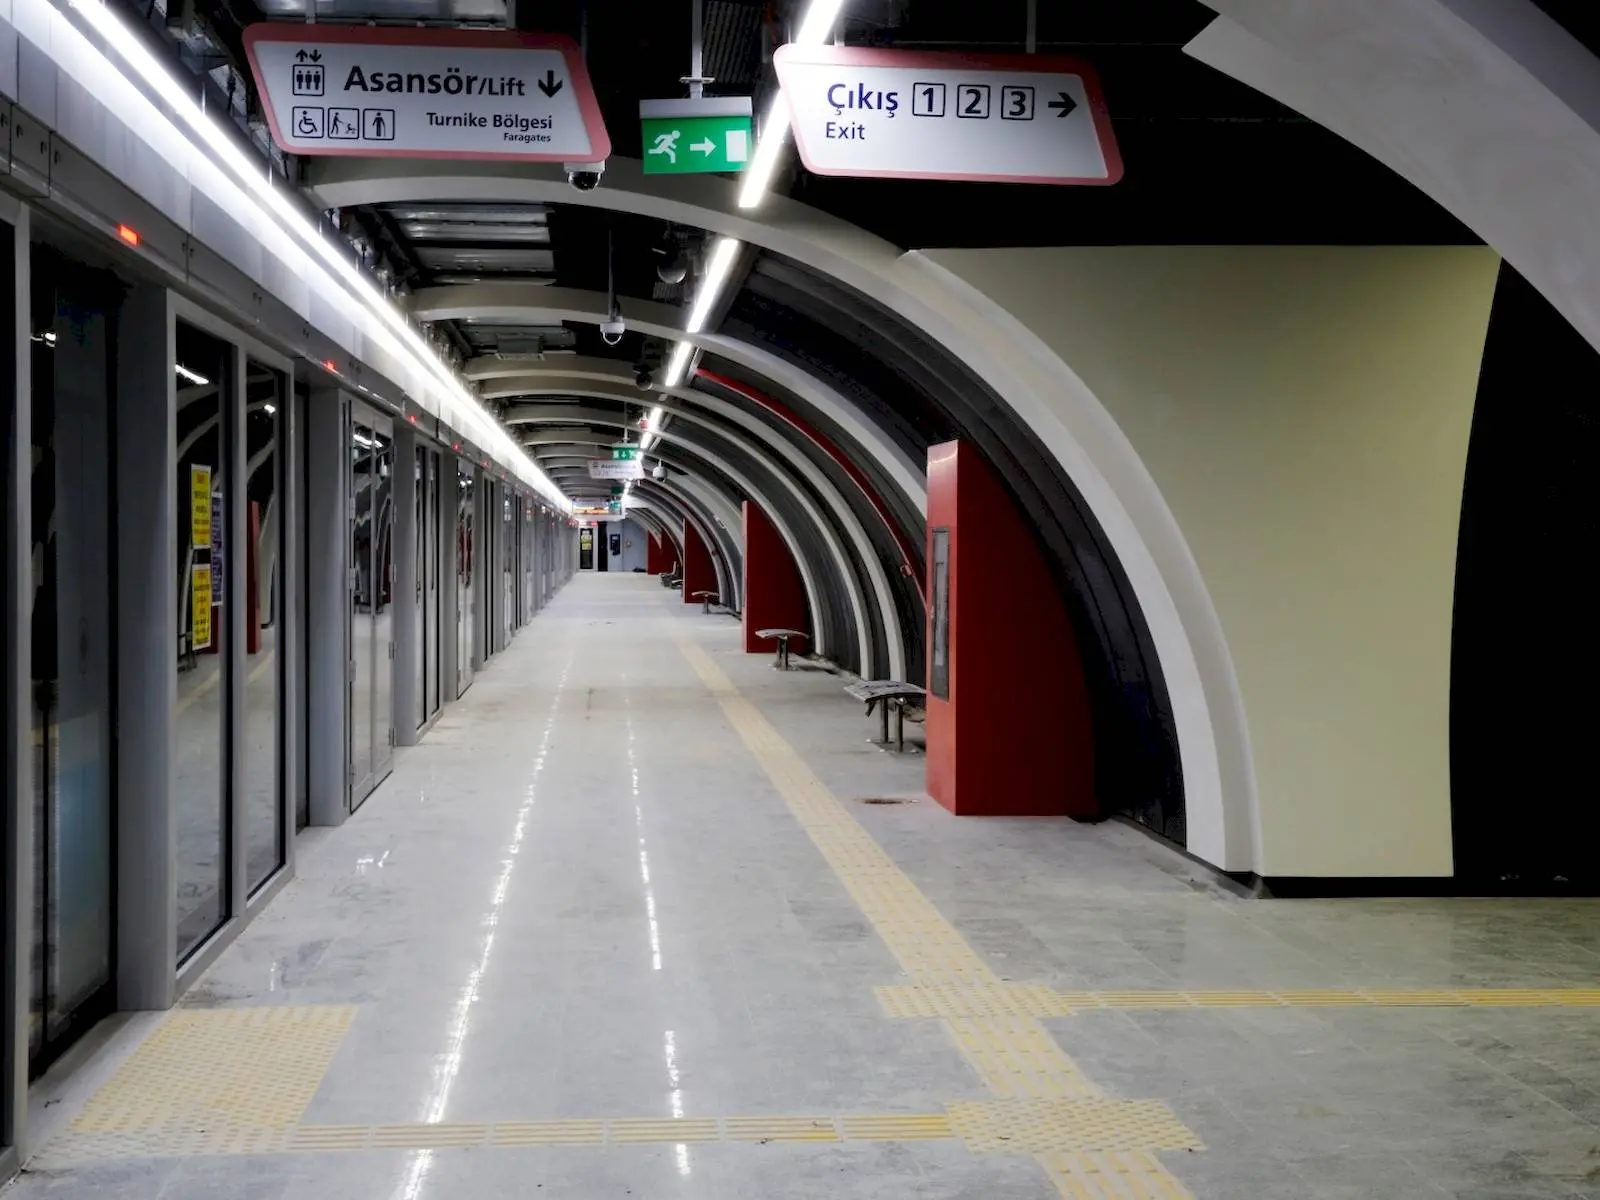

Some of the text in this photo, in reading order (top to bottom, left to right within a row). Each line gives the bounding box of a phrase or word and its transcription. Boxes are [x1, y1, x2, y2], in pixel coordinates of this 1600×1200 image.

[344, 65, 525, 96] Asansör/Lift
[827, 82, 1026, 118] Çıkış 1 2 3
[427, 111, 552, 132] Turnike Bölgesi
[826, 121, 865, 141] Exit
[503, 132, 552, 144] Faragates
